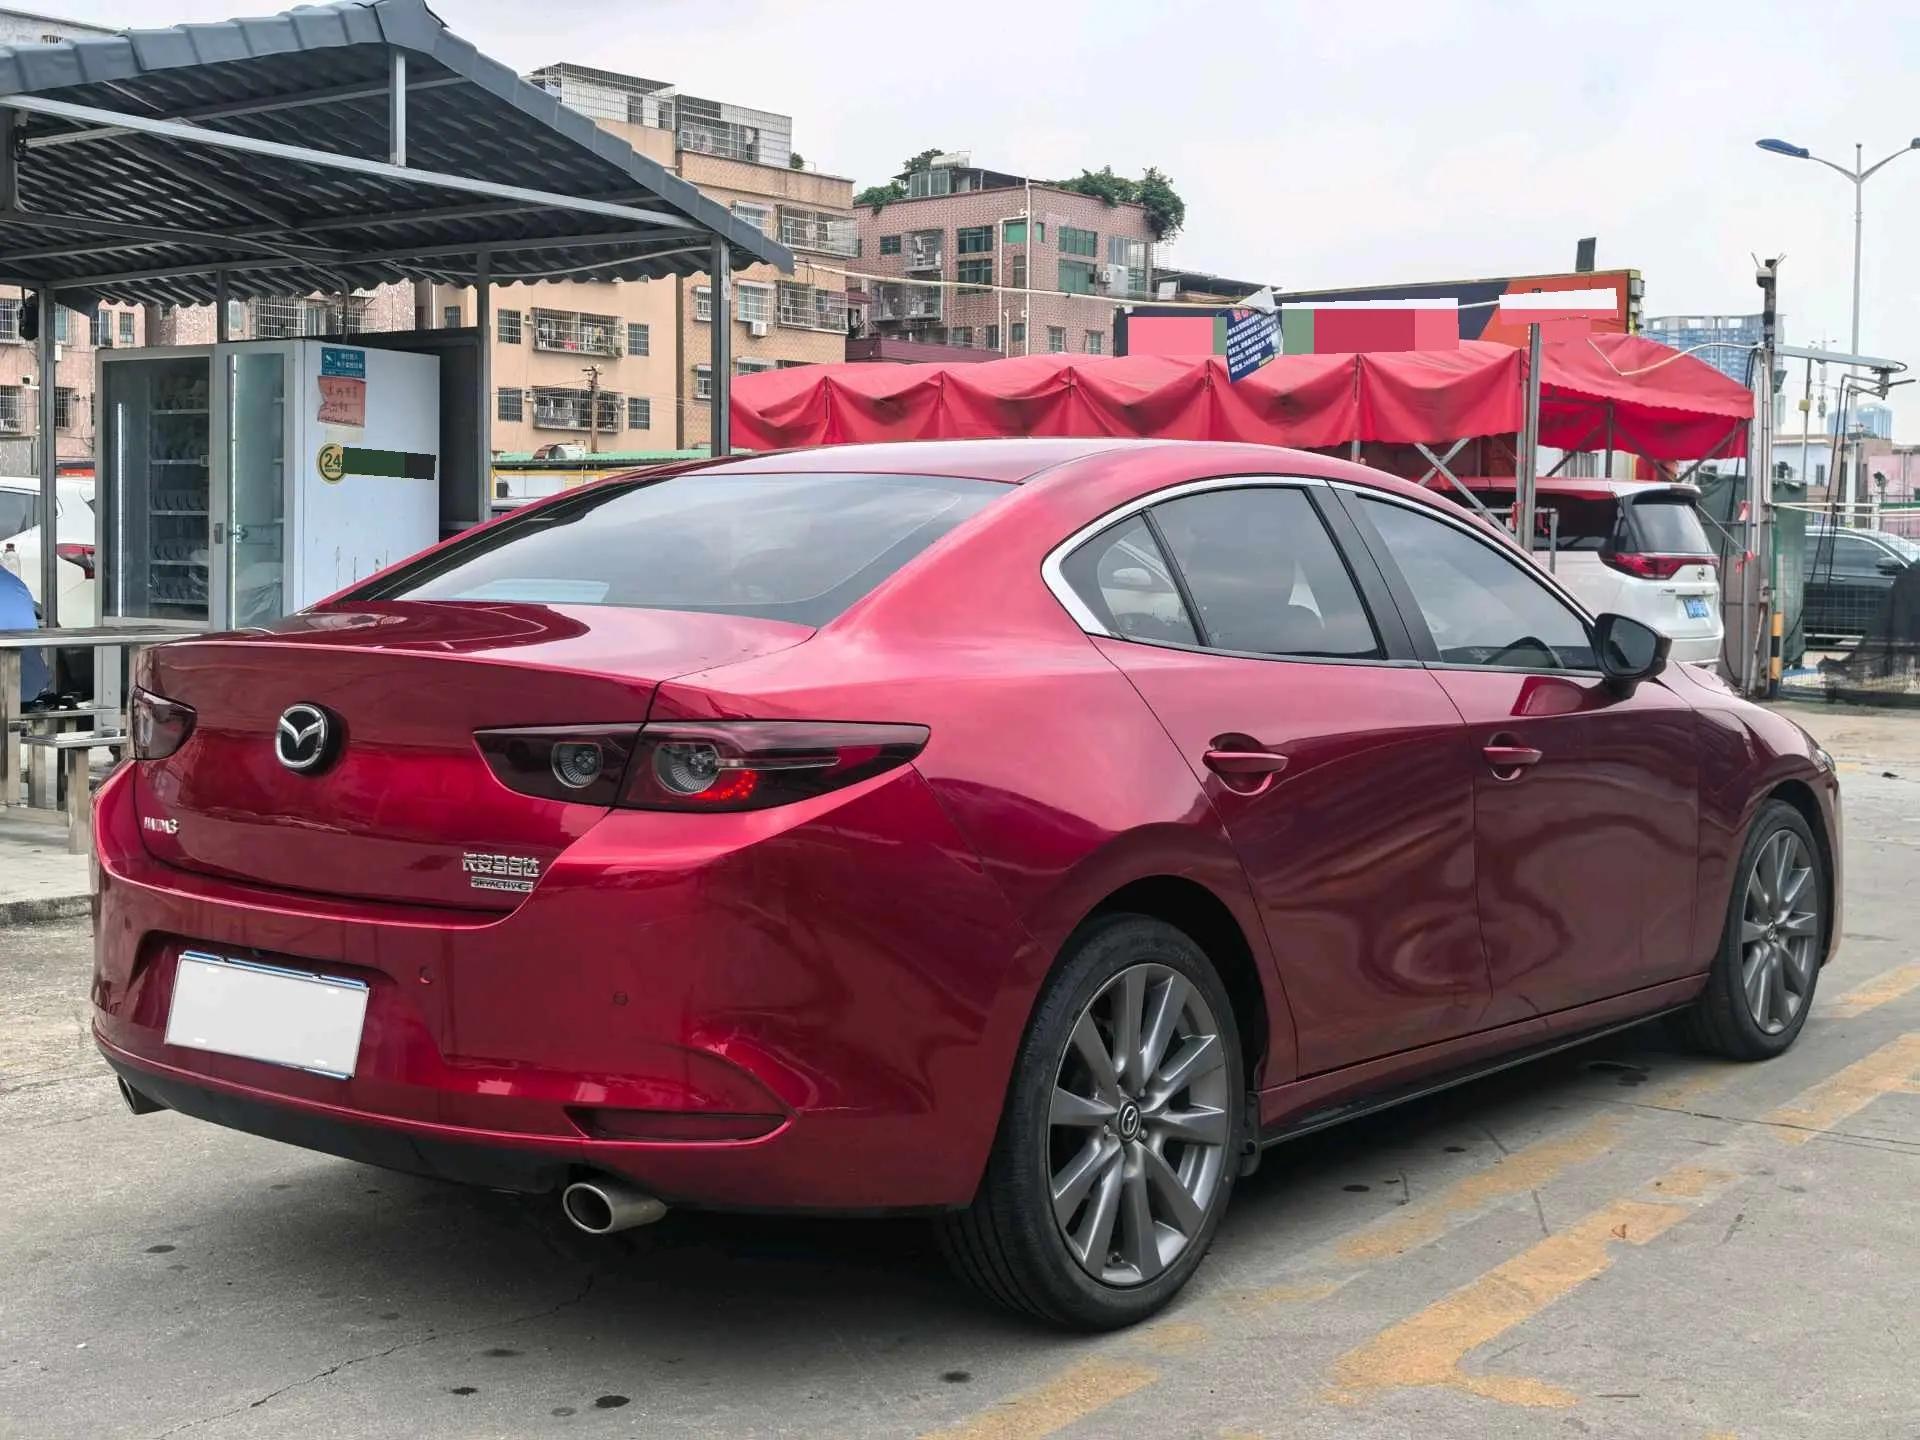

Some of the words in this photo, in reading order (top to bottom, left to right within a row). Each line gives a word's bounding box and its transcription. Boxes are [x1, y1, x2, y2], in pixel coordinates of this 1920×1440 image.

[325, 452, 341, 468] 24
[462, 851, 540, 878] 长安马自达
